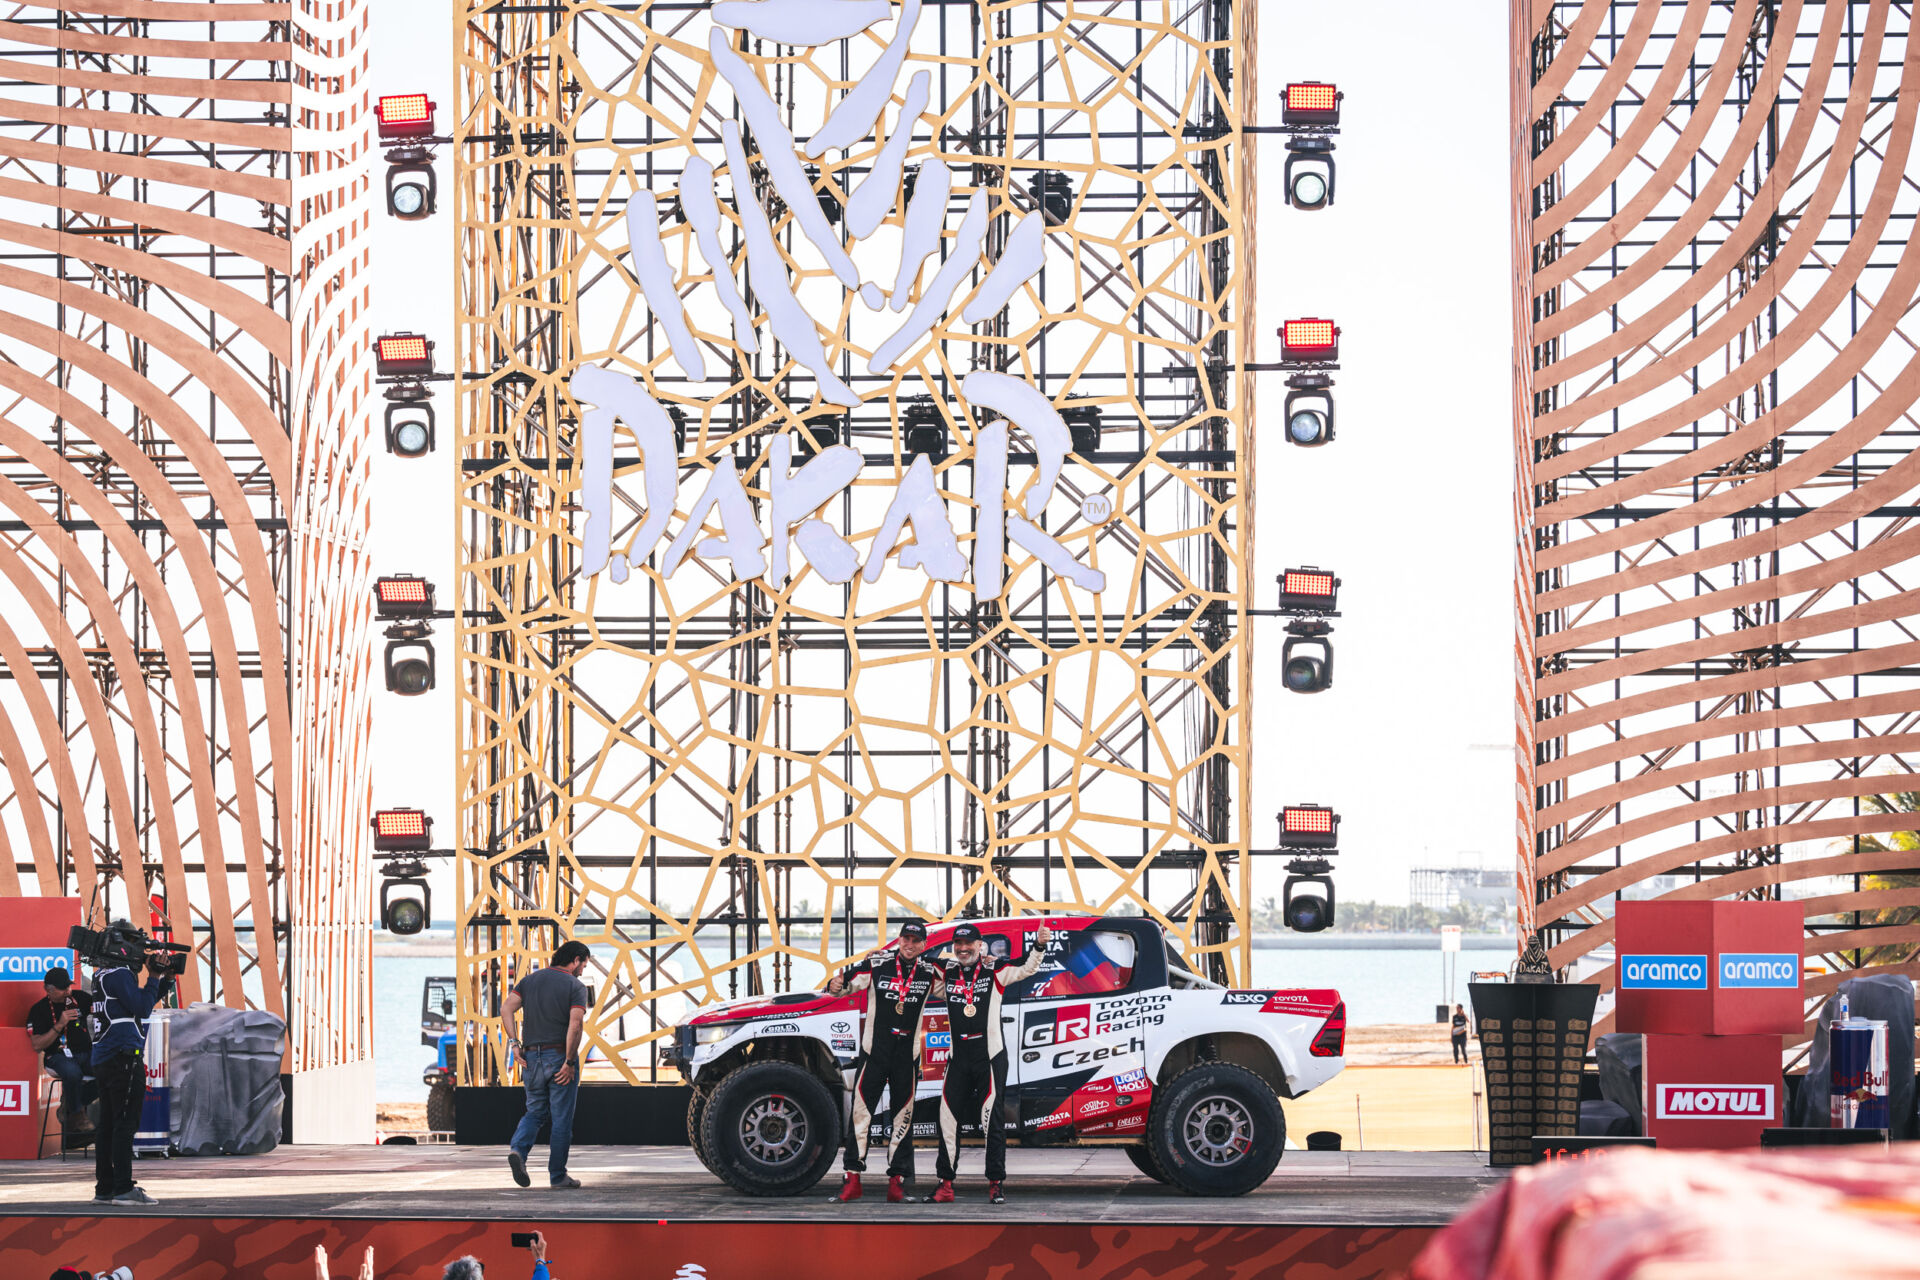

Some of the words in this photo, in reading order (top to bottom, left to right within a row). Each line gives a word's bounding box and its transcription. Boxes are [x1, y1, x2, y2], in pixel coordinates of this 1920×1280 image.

[569, 362, 1107, 600] DAKAR
[1085, 501, 1107, 515] TM
[1024, 930, 1069, 941] MSIC
[1025, 941, 1064, 951] DTA
[1519, 961, 1550, 975] DAKAR
[1627, 962, 1702, 980] aramco
[1724, 961, 1793, 980] aramco
[946, 983, 963, 994] GR
[966, 977, 991, 986] TOTA
[884, 993, 918, 1003] Czch
[949, 995, 980, 1003] Czeh
[1096, 994, 1172, 1010] TOYOTA
[1227, 993, 1268, 1004] NEXO
[1273, 995, 1309, 1003] TOYOTA
[1096, 1004, 1166, 1023] GAZOO
[1023, 1017, 1089, 1047] GR
[1096, 1014, 1164, 1035] Racing
[1052, 1037, 1145, 1069] Czech
[1115, 1069, 1144, 1085] LIQUI
[1833, 1071, 1860, 1087] Red
[1863, 1071, 1889, 1087] Bull
[1118, 1079, 1146, 1092] MOLY
[1669, 1091, 1762, 1112] MOTUL
[896, 1108, 911, 1140] HILUX
[1024, 1111, 1070, 1127] MUSICDATA
[1117, 1115, 1142, 1127] ENDLESS
